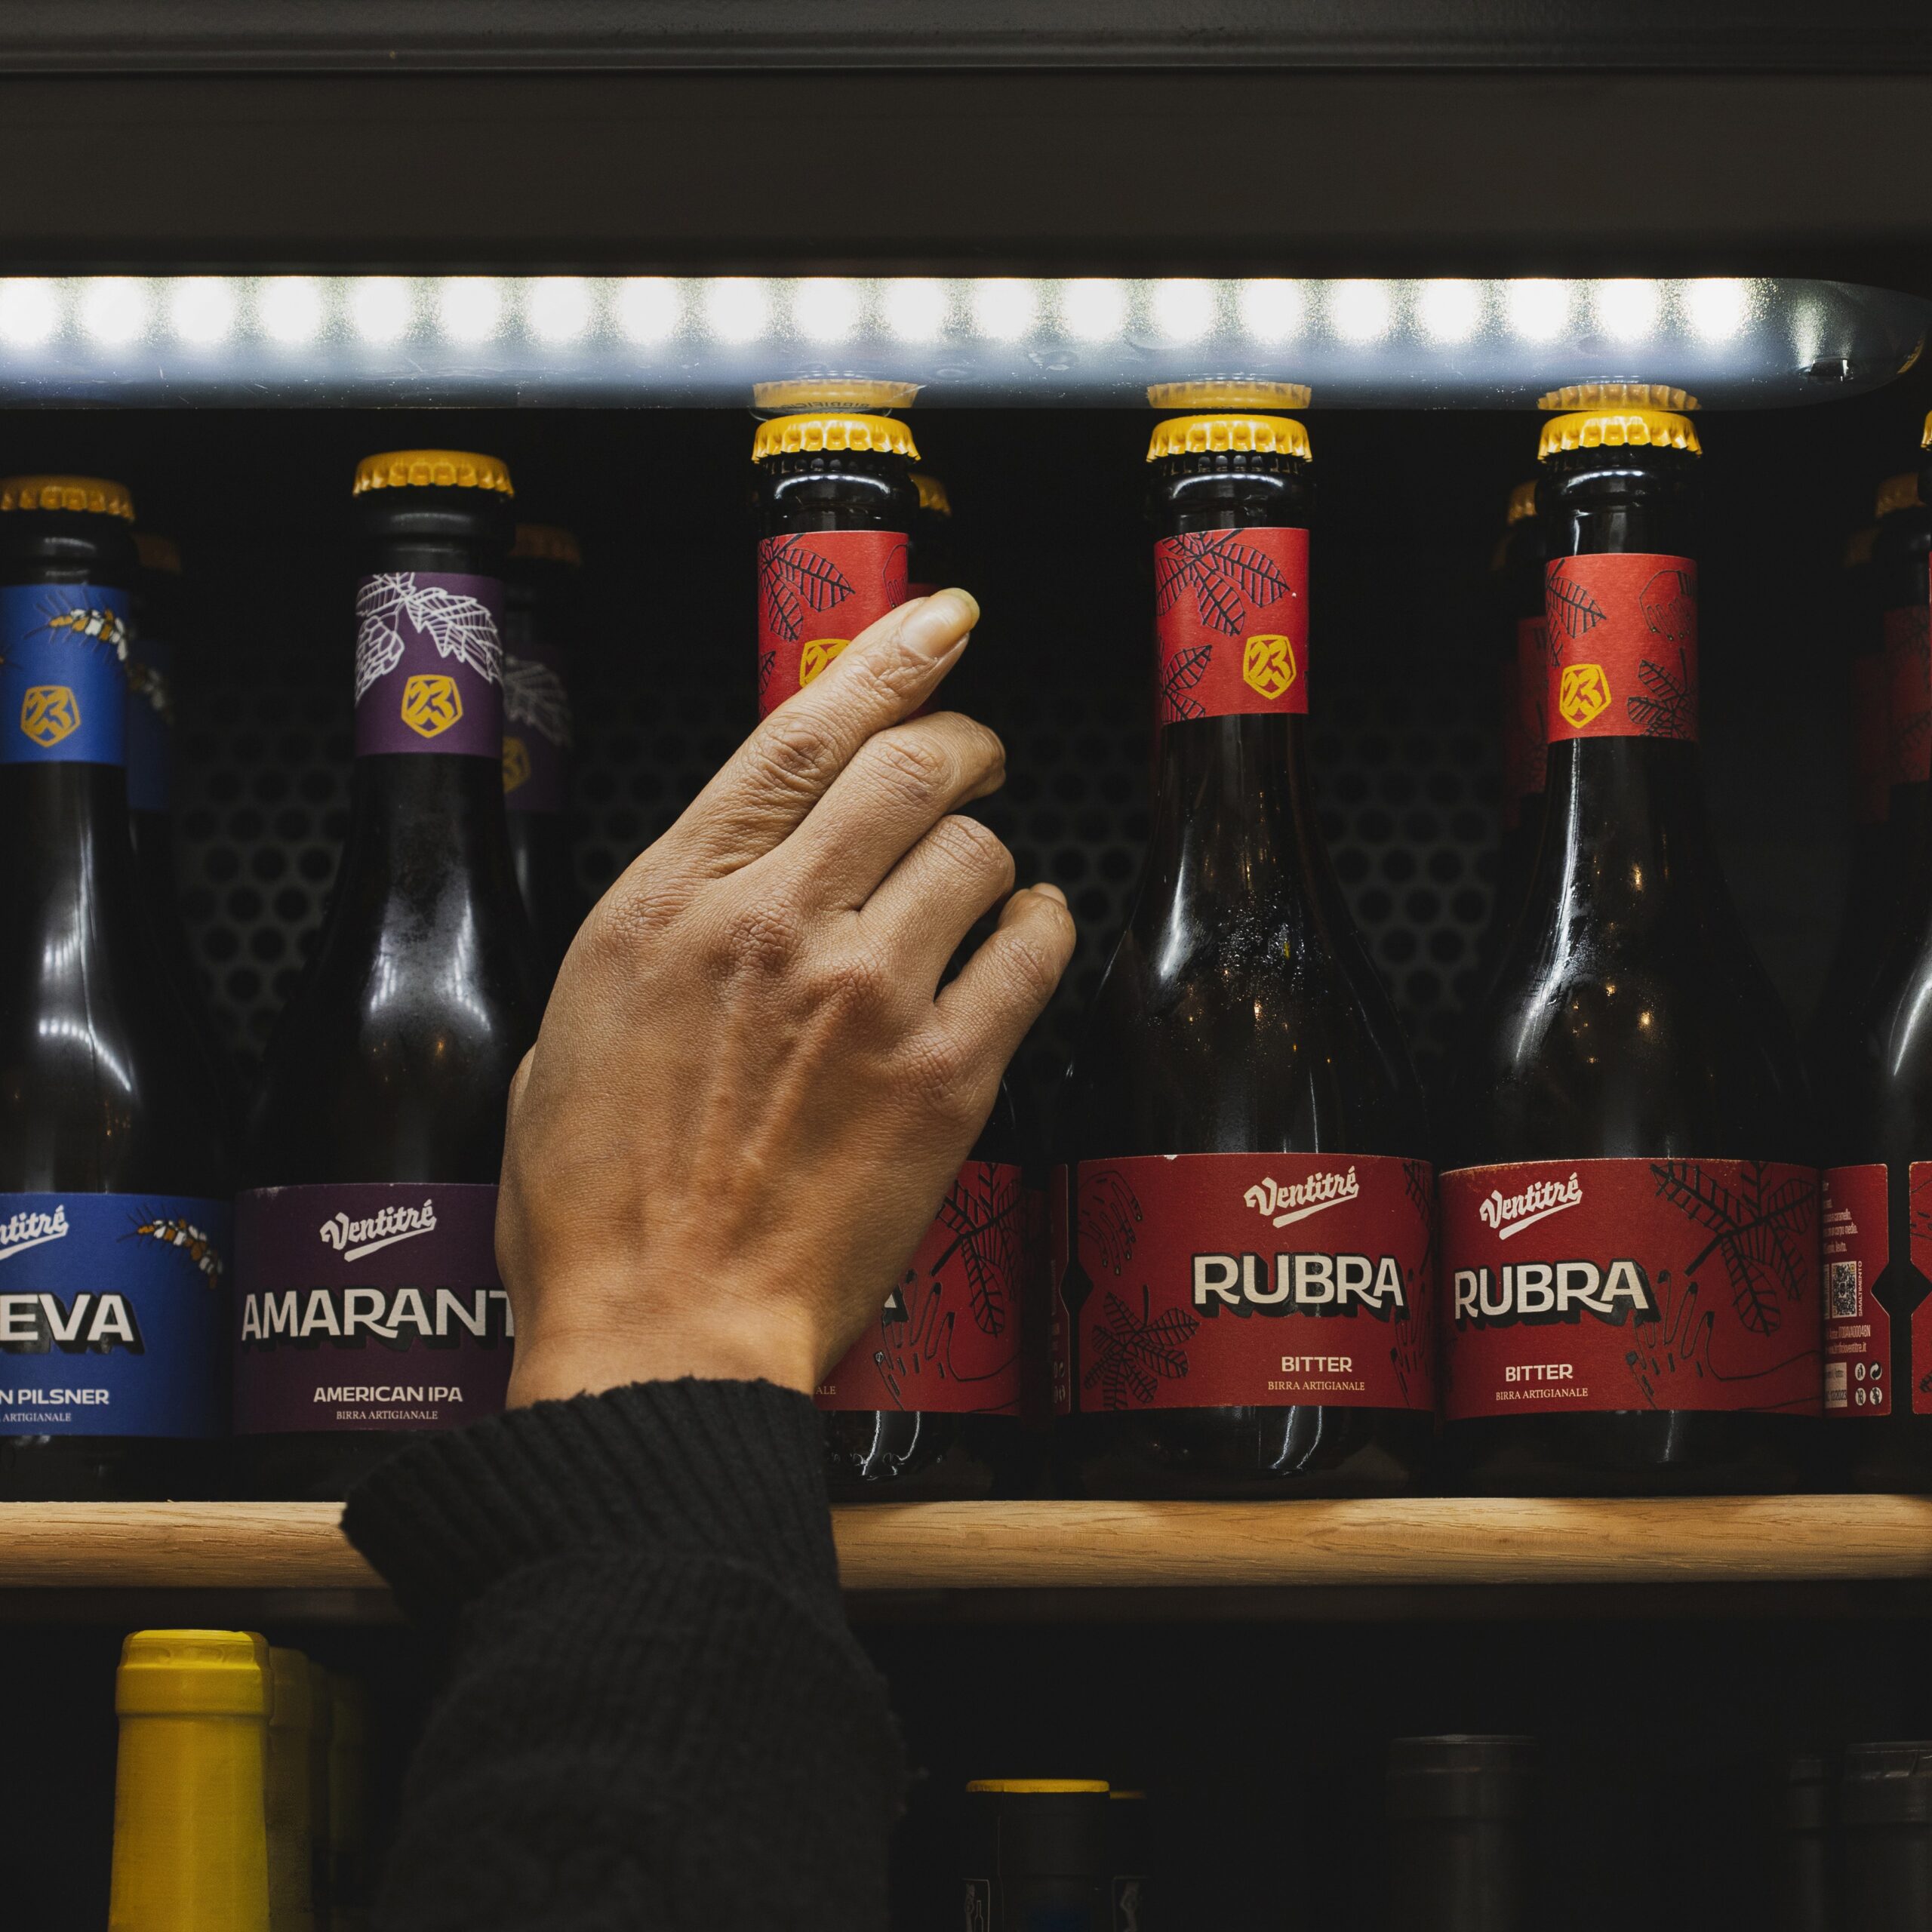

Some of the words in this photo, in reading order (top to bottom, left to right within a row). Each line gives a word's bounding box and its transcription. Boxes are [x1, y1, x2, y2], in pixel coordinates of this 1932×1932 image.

[1243, 1165, 1359, 1229] Ventitré
[1479, 1172, 1583, 1240] Ventitré
[320, 1199, 437, 1262] Ventitré
[1194, 1255, 1404, 1309] RUBRA
[1455, 1261, 1649, 1319] RUBRA
[1281, 1356, 1352, 1373] BITTER
[1506, 1364, 1574, 1382] BITTER
[313, 1386, 423, 1402] AMERICAN
[429, 1386, 463, 1402] IPA
[1268, 1381, 1300, 1390] BIRRA
[1303, 1381, 1365, 1391] ARTIGIANALE
[1496, 1391, 1521, 1401] BIRRA
[1522, 1388, 1589, 1399] ARTIGIANALE
[18, 1389, 109, 1404] PILSNER
[2, 1413, 72, 1422] ARTIGIANALE
[336, 1411, 365, 1420] BIRRA
[368, 1411, 438, 1420] ARTIGIANALE
